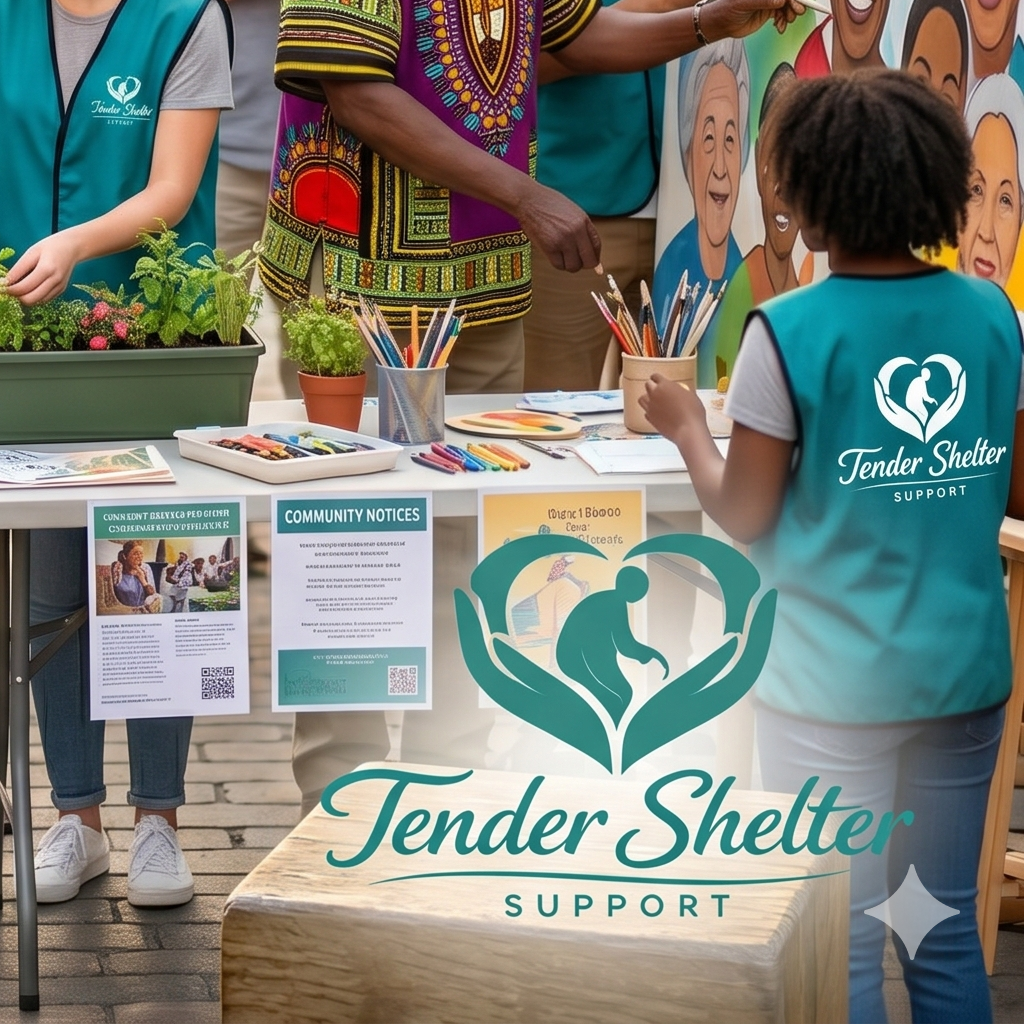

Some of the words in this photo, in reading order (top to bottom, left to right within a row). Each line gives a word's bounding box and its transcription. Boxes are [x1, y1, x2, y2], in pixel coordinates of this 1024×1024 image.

[838, 445, 923, 485] Tender
[928, 437, 1007, 477] Shelter
[894, 485, 967, 503] SUPPORT
[284, 508, 363, 524] COMMUNITY
[366, 507, 420, 522] NOTICES
